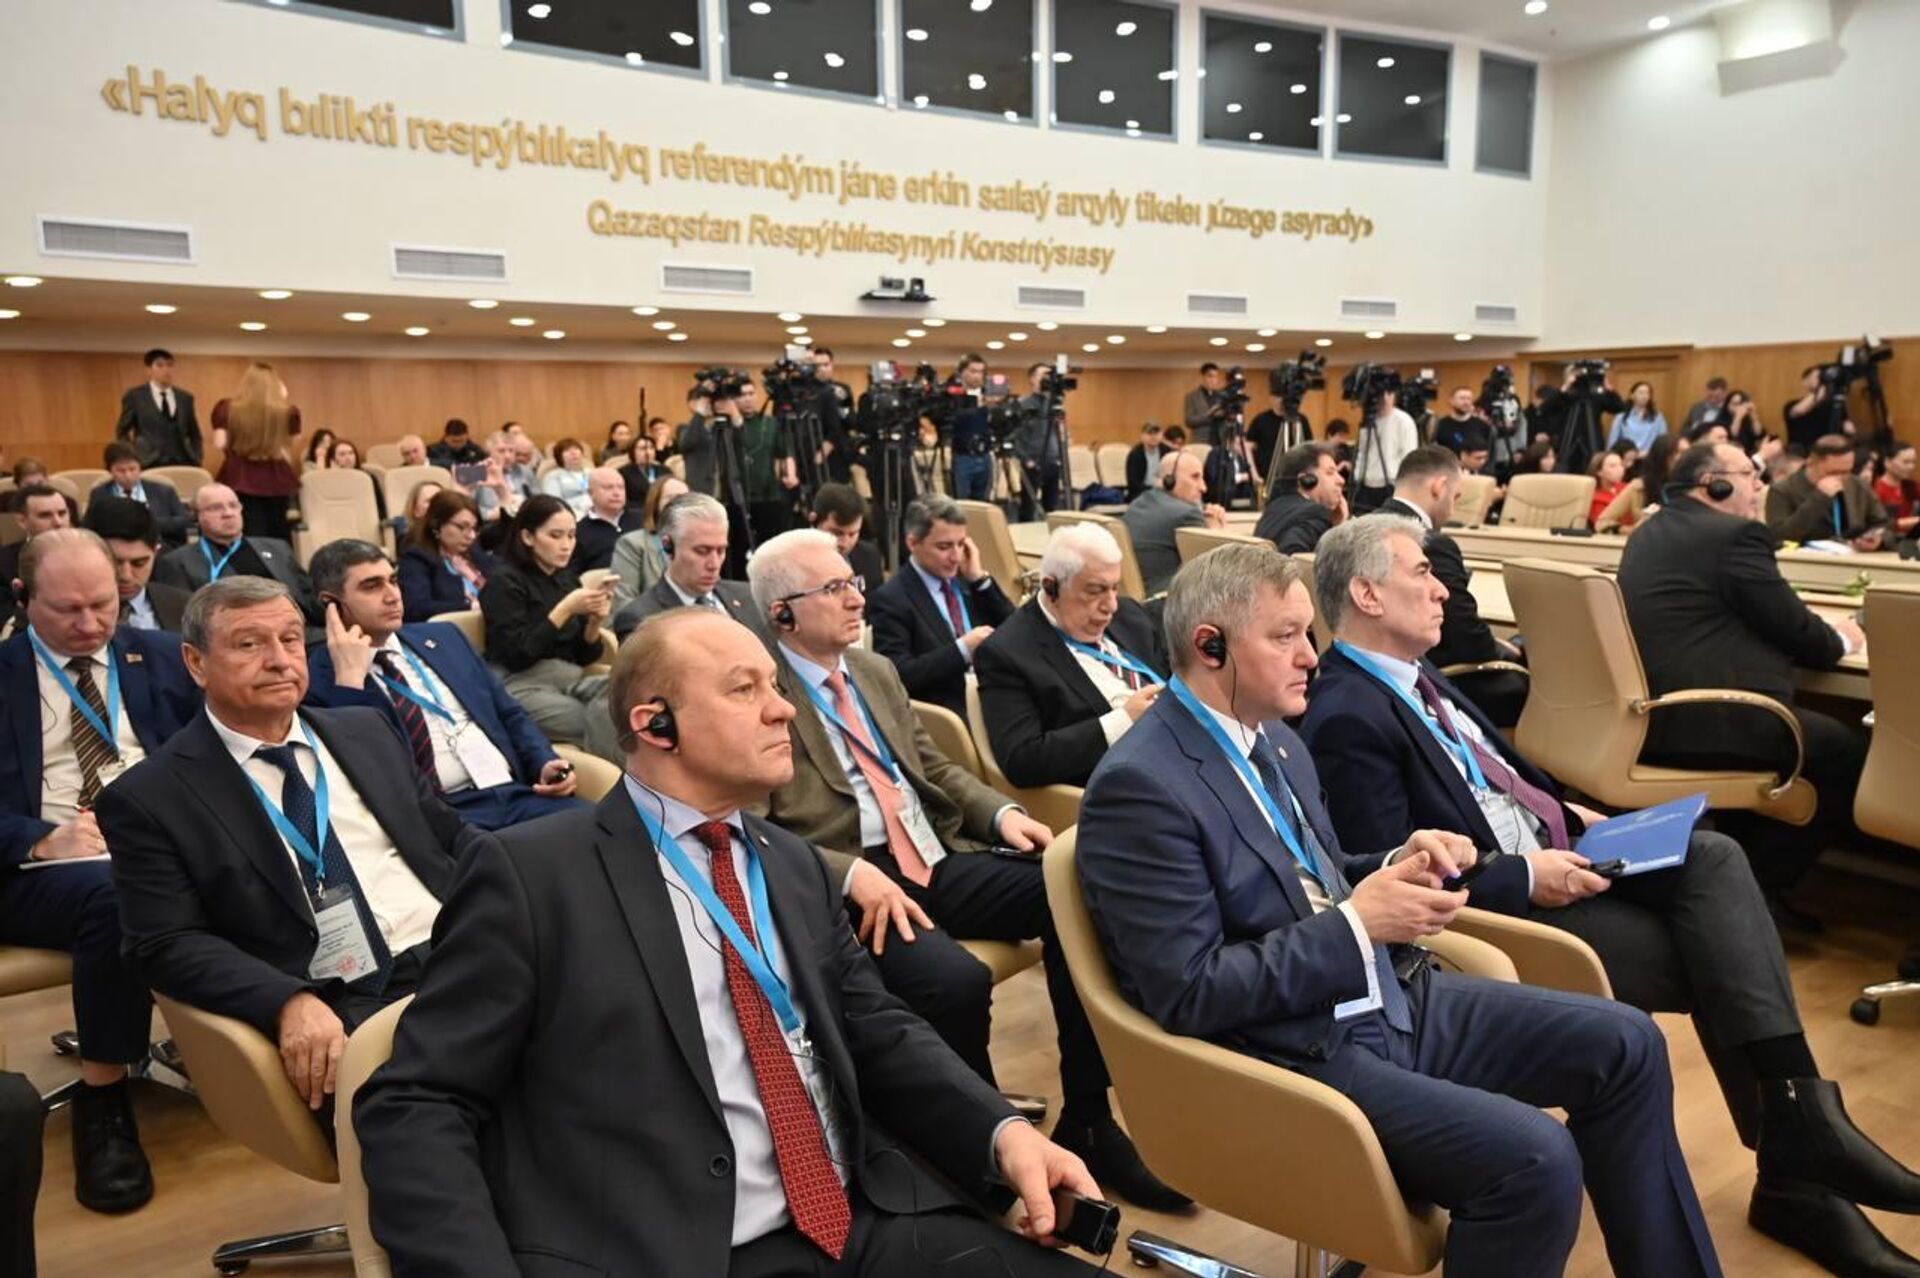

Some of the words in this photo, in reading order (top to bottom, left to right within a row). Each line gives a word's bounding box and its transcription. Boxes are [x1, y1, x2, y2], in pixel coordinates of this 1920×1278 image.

[659, 141, 834, 201] referendým
[838, 160, 897, 205] jáne
[904, 170, 971, 208] erkin
[1055, 188, 1130, 228] arqyly
[587, 197, 741, 247] Qazaqstan
